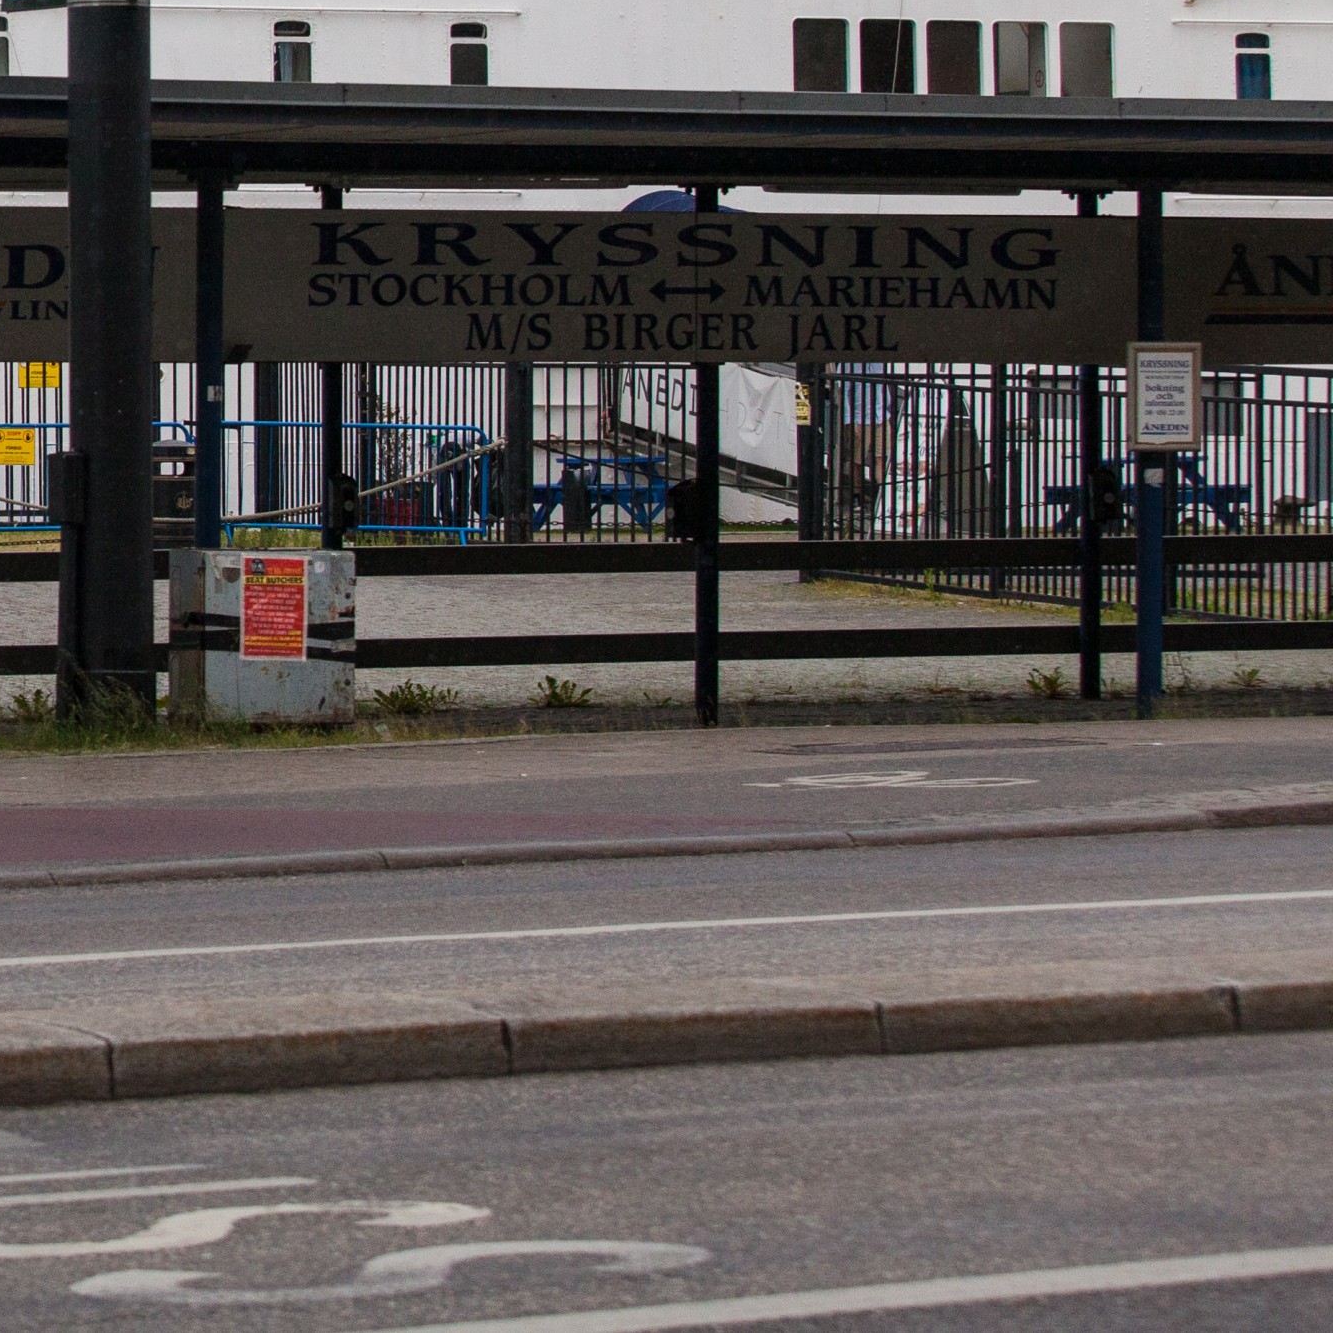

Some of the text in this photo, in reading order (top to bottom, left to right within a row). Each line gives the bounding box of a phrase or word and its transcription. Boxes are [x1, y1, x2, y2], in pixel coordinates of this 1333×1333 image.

[310, 222, 1062, 270] KRYSSNING
[308, 273, 1058, 310] STOCKHOLM MARIEHAMN
[465, 313, 899, 362] M/S BIRGER JARL
[1140, 360, 1190, 368] KRYSSNING
[1145, 384, 1185, 394] bokning
[1142, 422, 1190, 431] ÅNEDIN
[245, 576, 264, 584] BEAT
